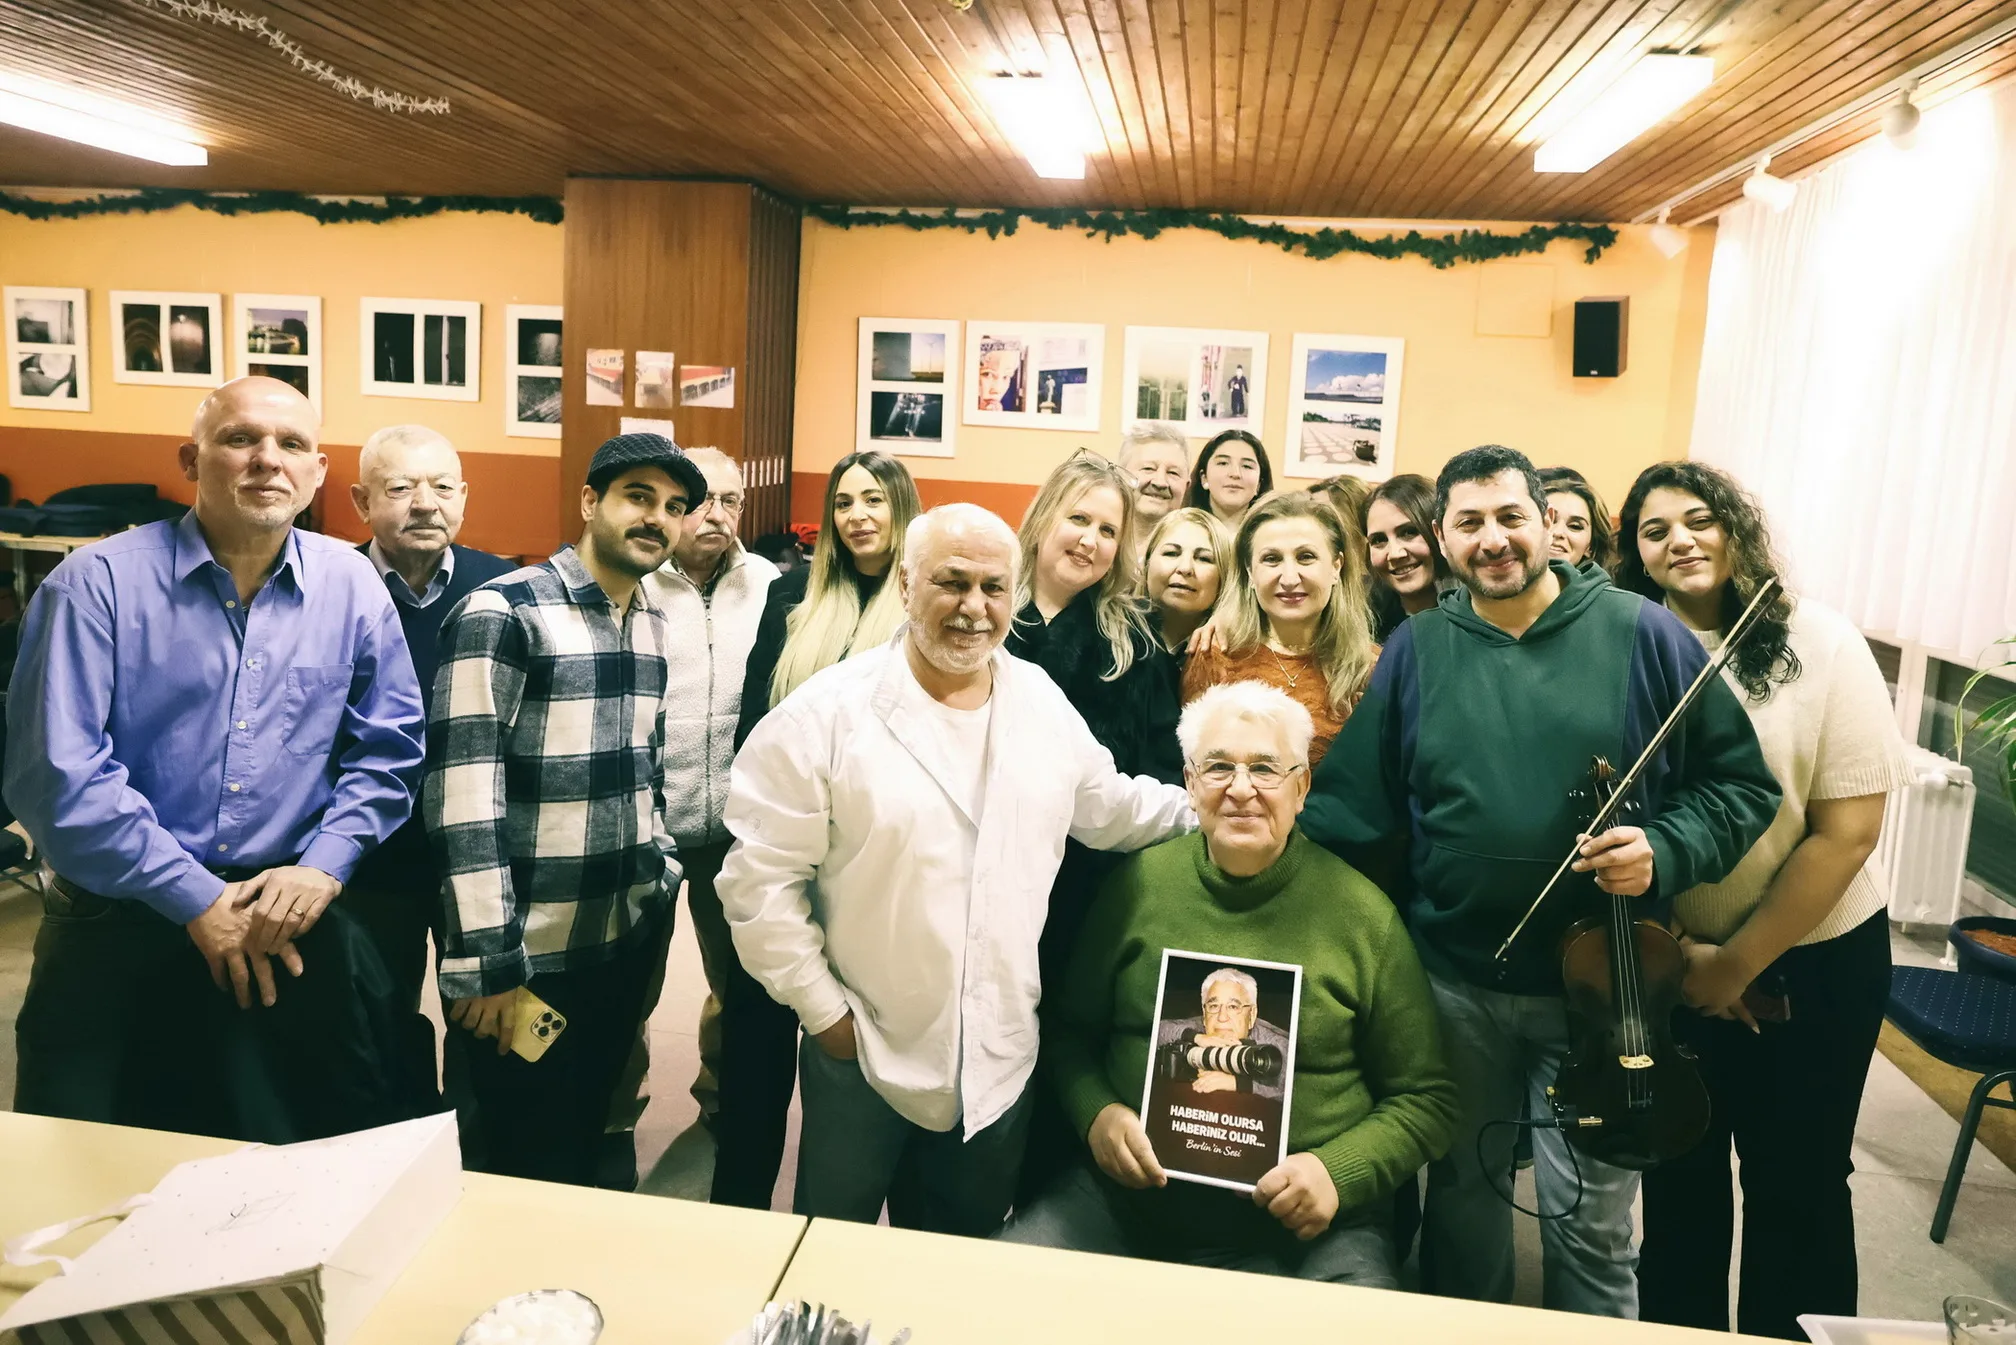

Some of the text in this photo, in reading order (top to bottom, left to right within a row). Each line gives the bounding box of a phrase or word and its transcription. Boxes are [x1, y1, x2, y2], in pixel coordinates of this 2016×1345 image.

[1220, 1114, 1264, 1132] OLURSA
[1228, 1131, 1265, 1147] OLUR...
[1222, 1146, 1242, 1158] Sesi
